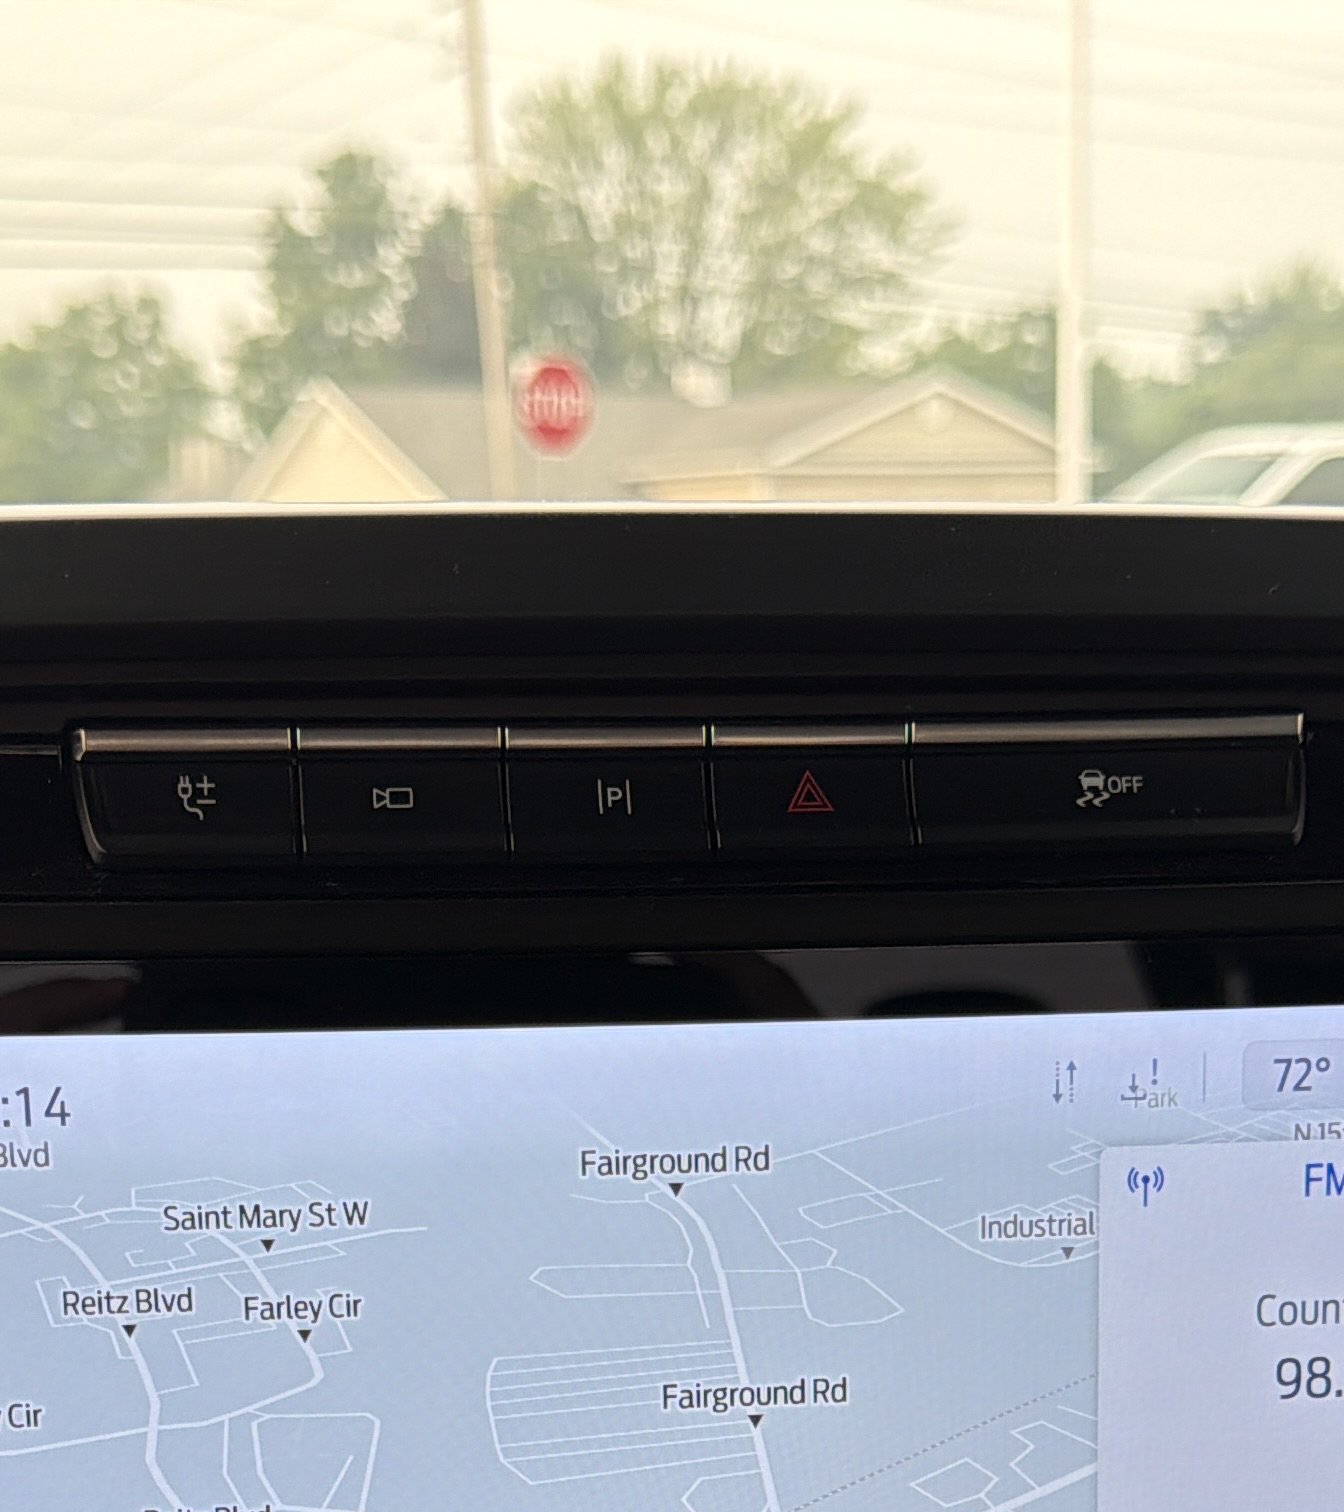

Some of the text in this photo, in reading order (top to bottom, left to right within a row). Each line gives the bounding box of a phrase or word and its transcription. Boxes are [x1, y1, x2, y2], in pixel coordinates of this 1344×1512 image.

[1107, 776, 1144, 794] OFF
[1273, 1056, 1331, 1093] 72°
[581, 1144, 770, 1180] Fairground Rd
[163, 1201, 369, 1233] Saint Mary St W
[981, 1210, 1096, 1239] Industrial
[62, 1286, 193, 1316] Reitz Blvd
[244, 1293, 362, 1324] Farley Cir
[661, 1376, 847, 1413] Fairground Rd
[7, 1403, 42, 1429] Cir
